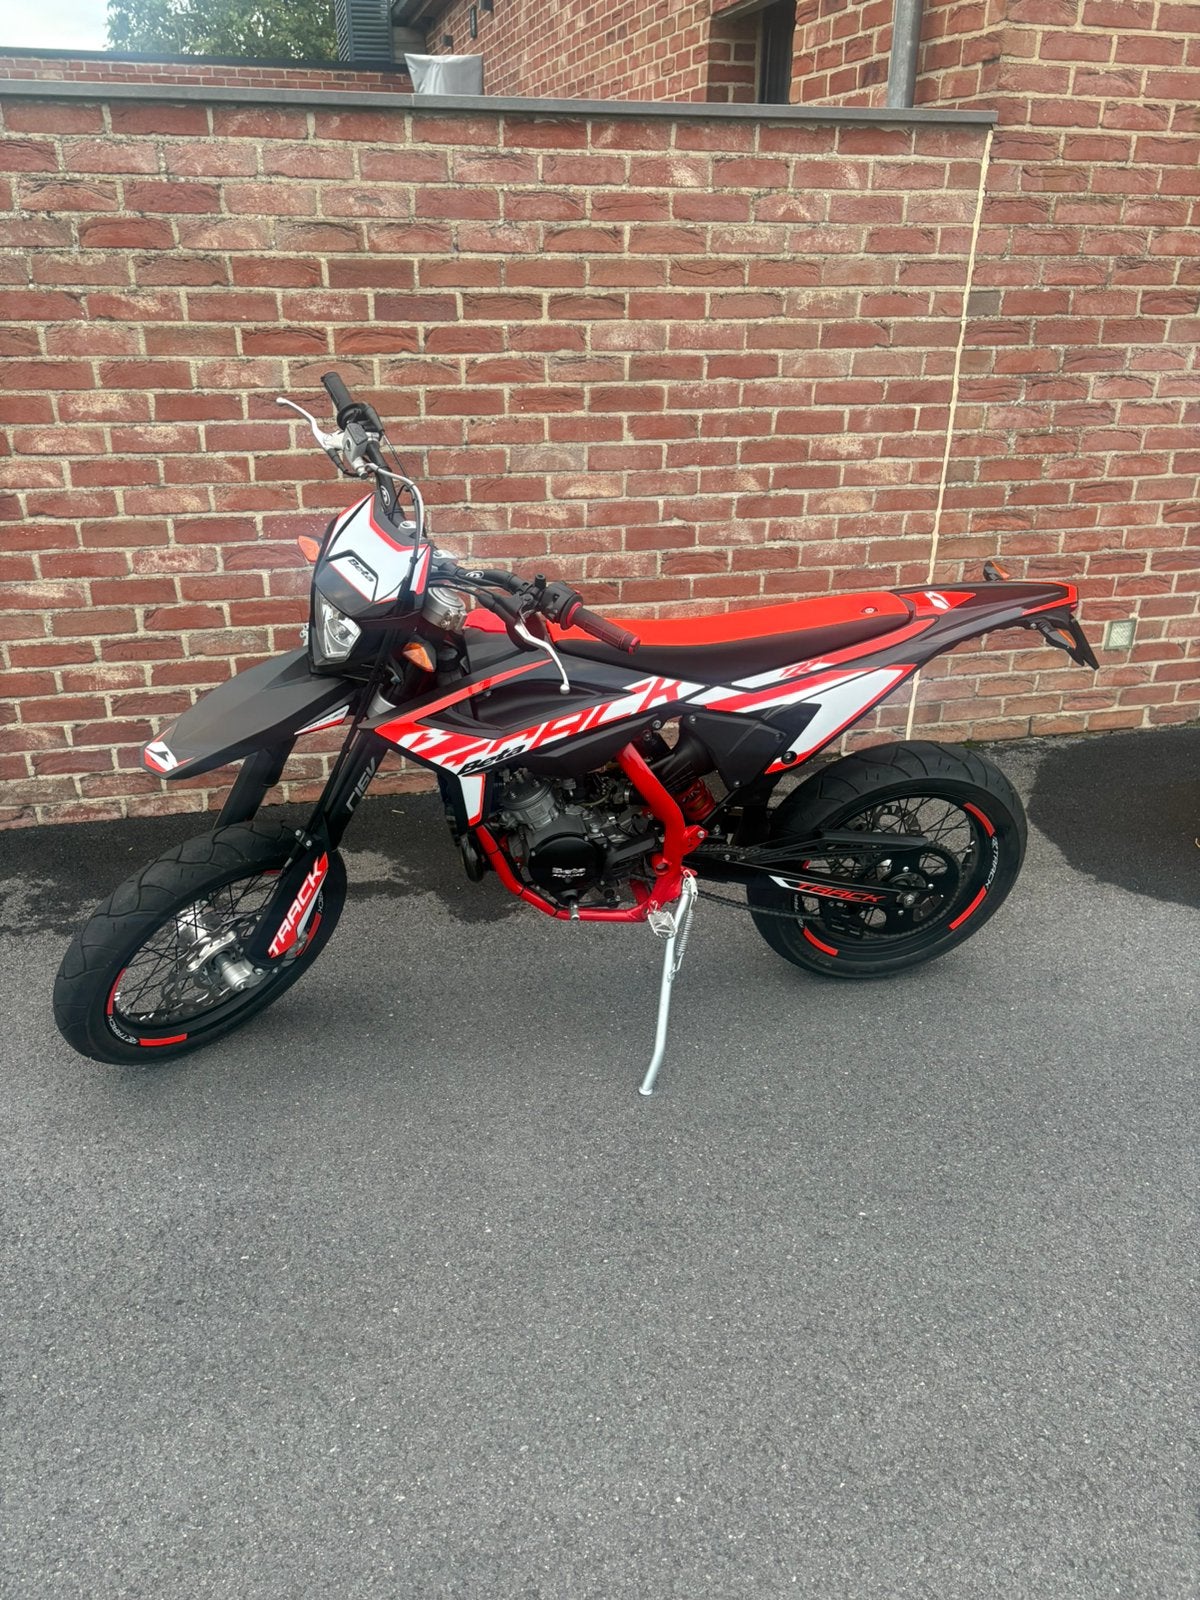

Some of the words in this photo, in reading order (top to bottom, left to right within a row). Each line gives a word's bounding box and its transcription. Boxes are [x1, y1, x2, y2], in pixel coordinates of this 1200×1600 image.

[347, 558, 374, 582] Beta
[441, 676, 682, 767] TRACK
[457, 744, 526, 775] Beta
[267, 856, 322, 955] TRACK
[798, 882, 887, 903] TRACK
